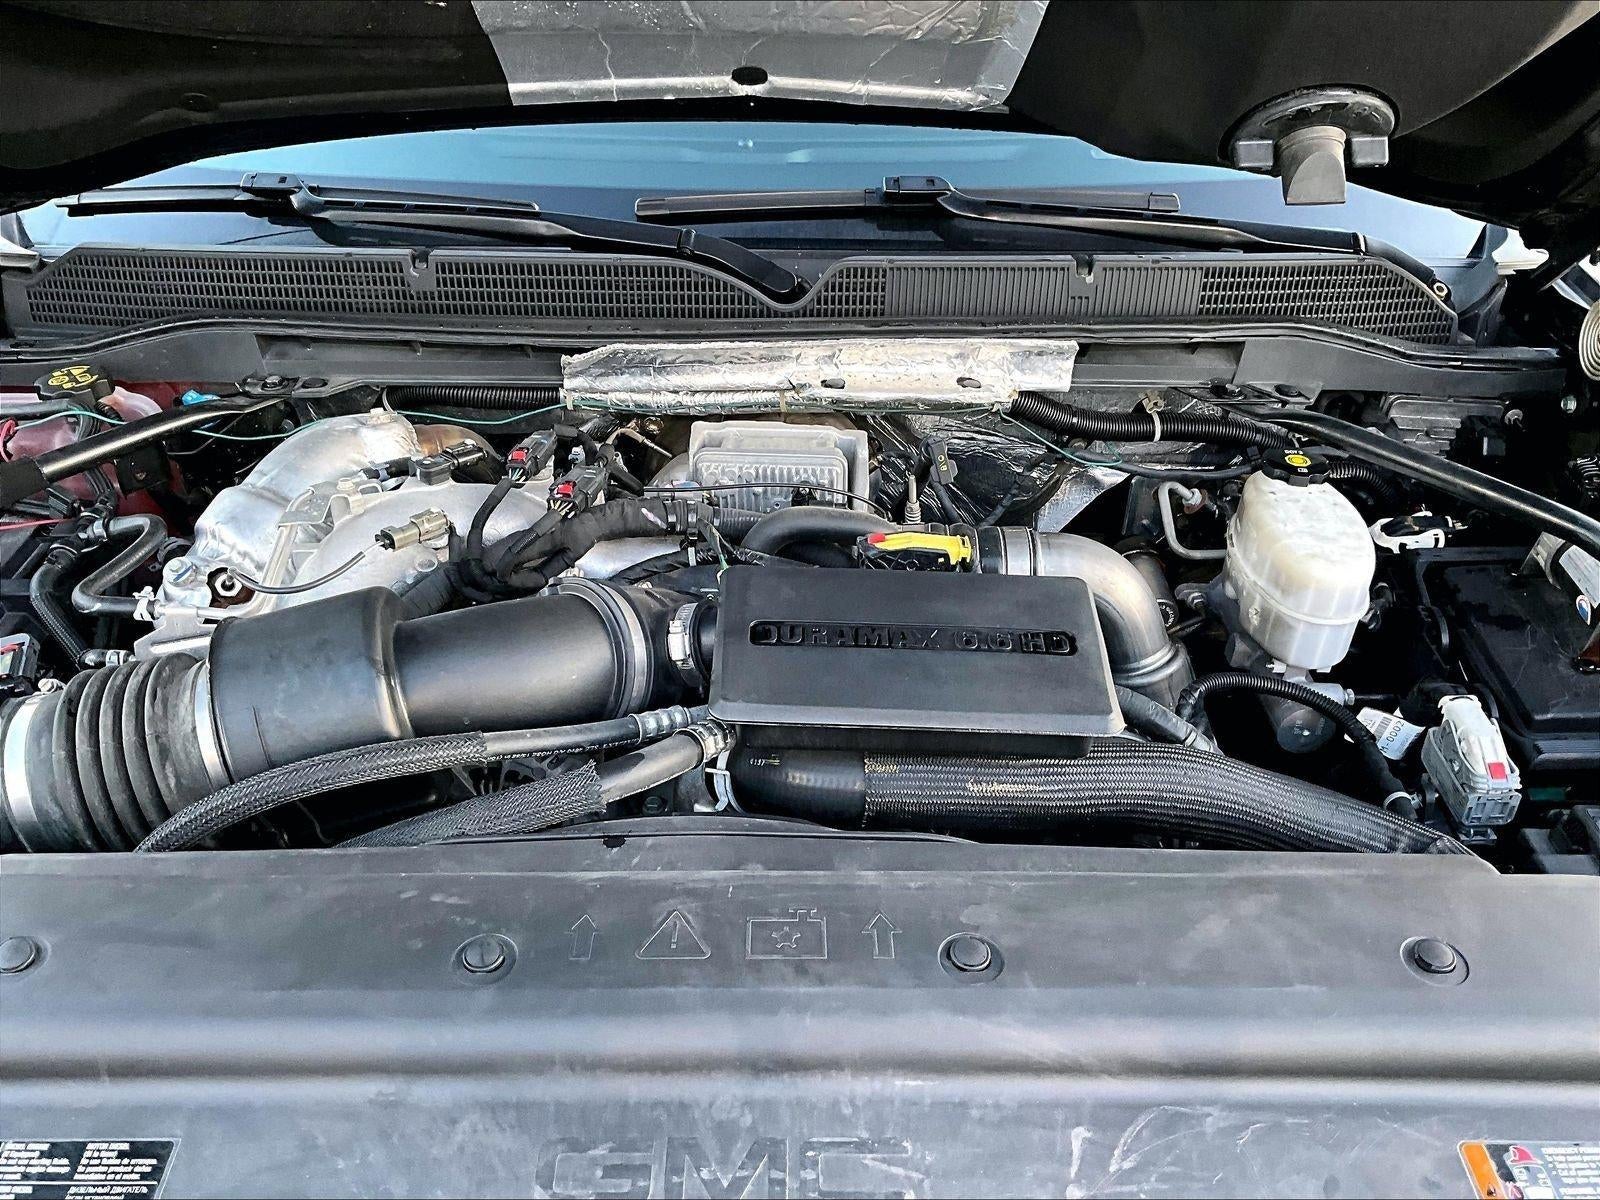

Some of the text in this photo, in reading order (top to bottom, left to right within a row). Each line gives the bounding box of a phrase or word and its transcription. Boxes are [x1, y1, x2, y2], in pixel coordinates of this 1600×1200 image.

[751, 623, 940, 649] DURAMAX
[1020, 632, 1072, 654] HD
[535, 1136, 912, 1199] GMC
